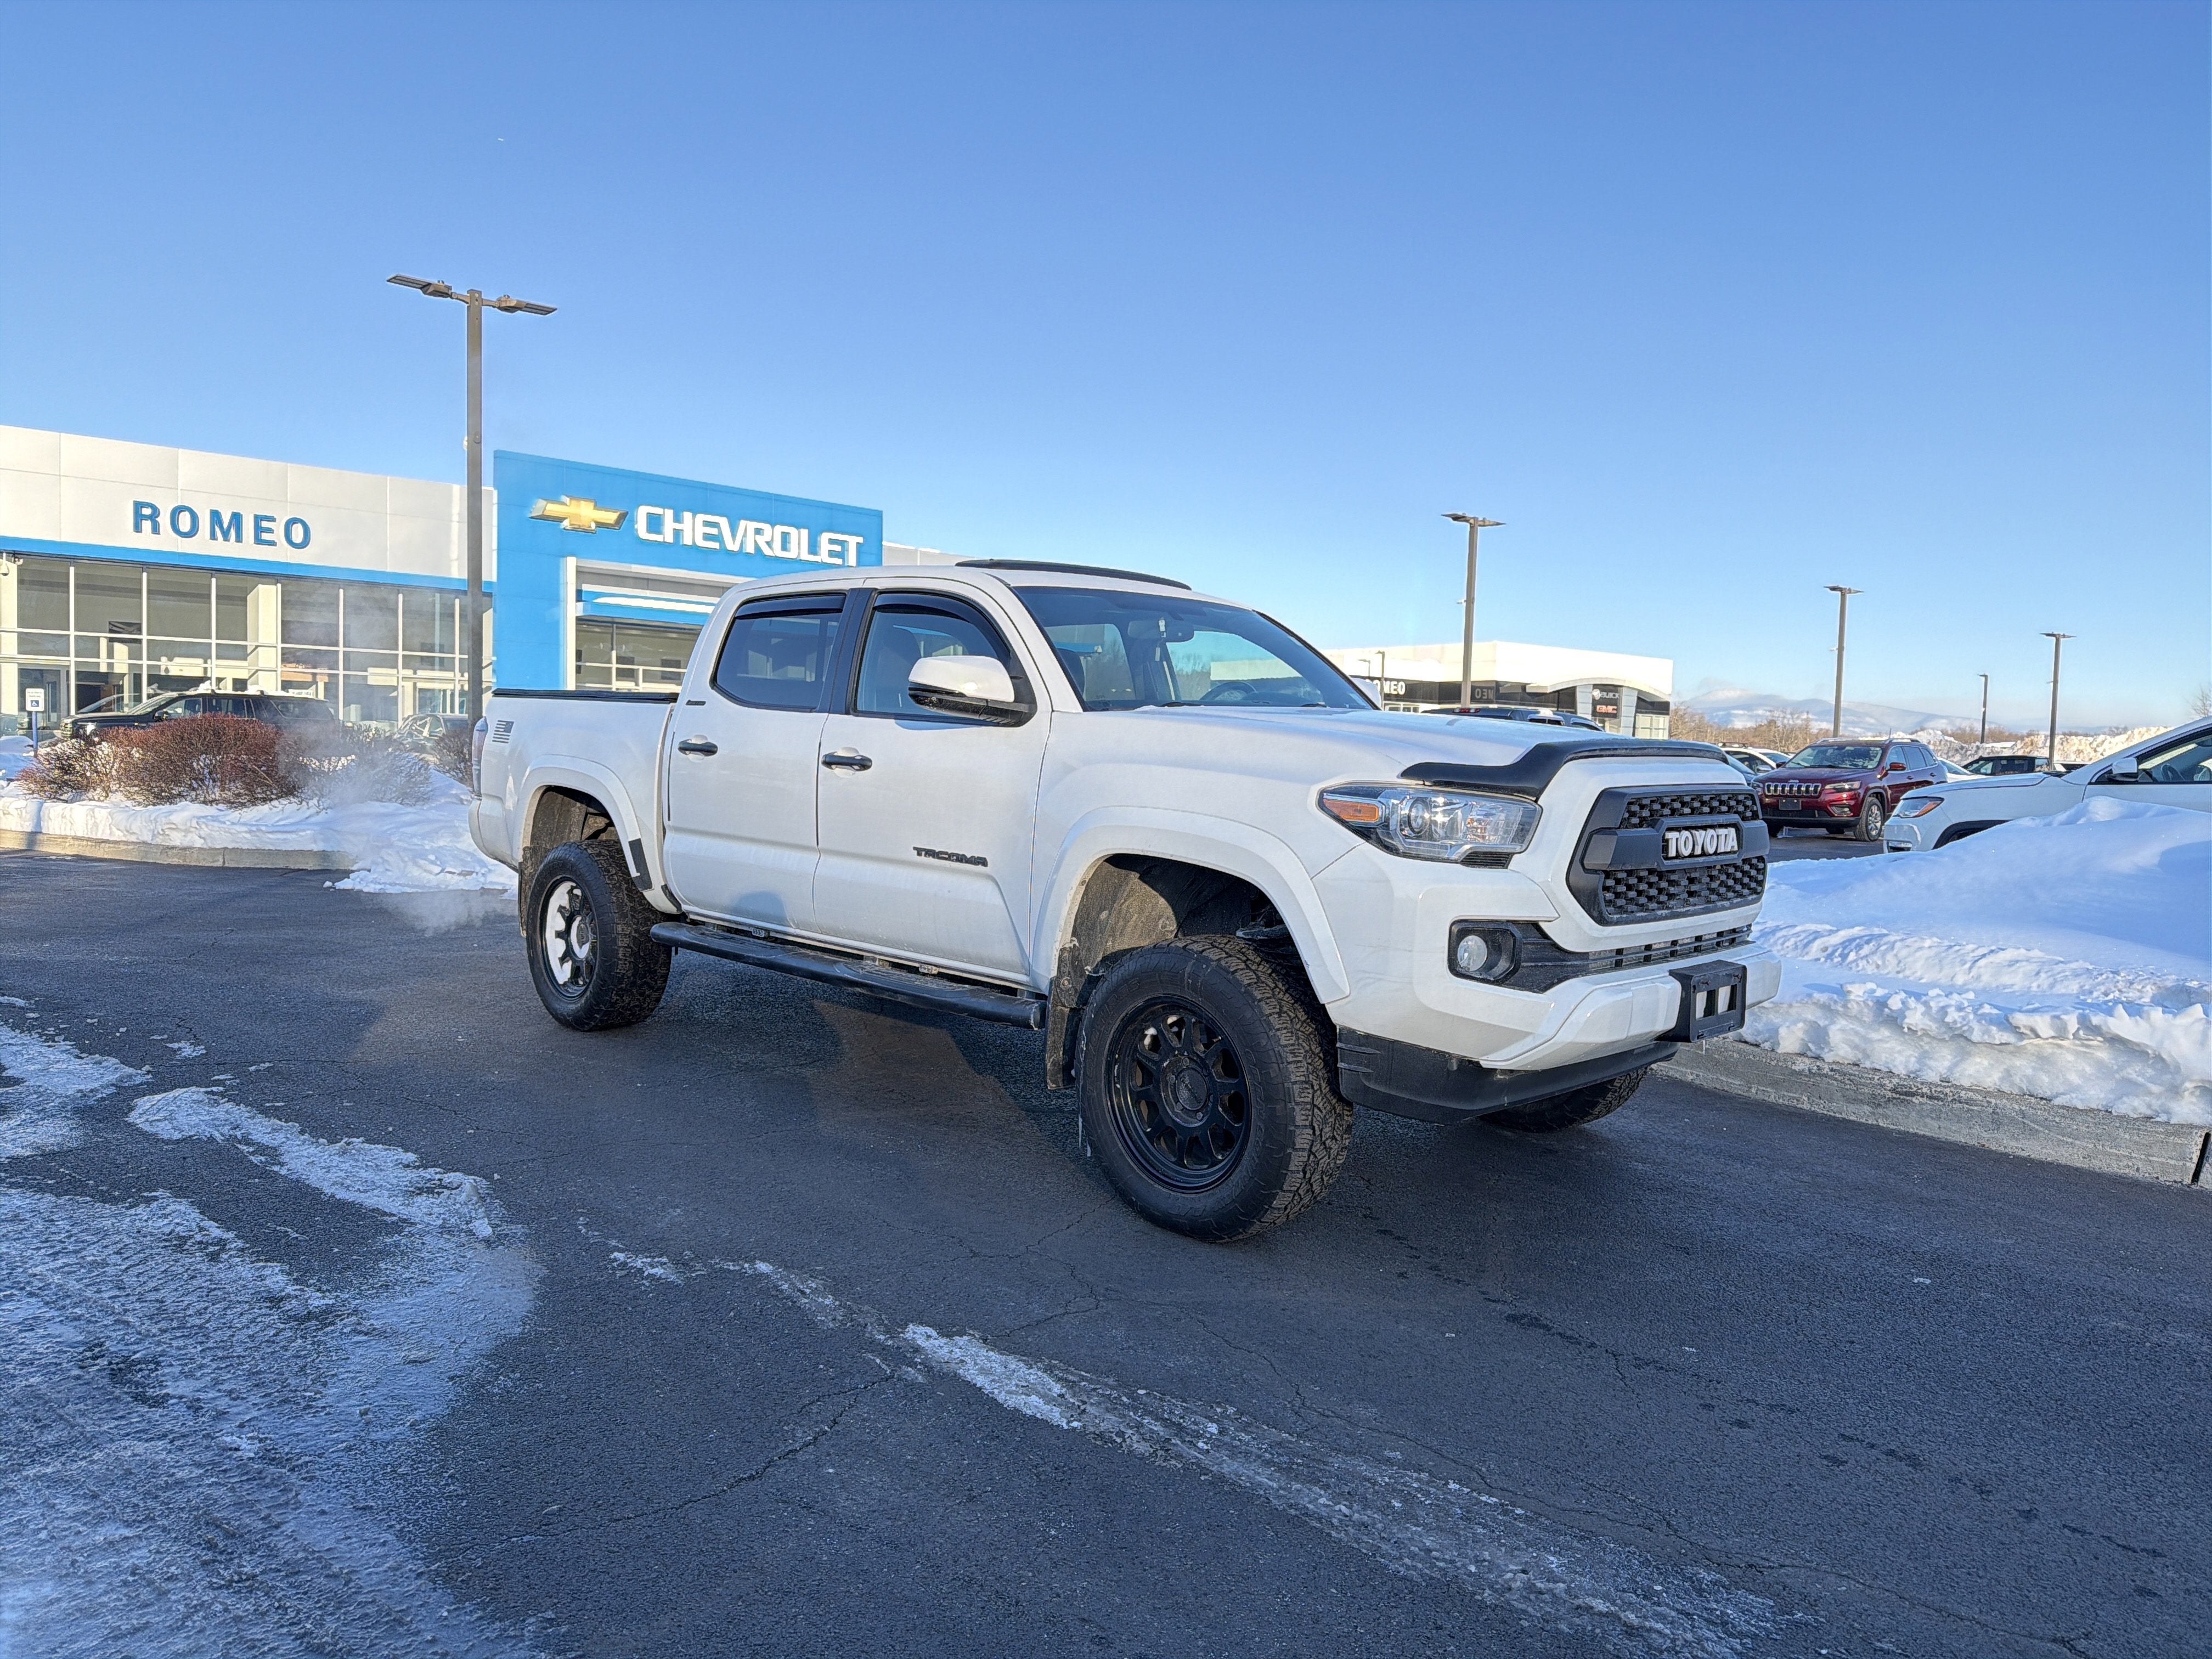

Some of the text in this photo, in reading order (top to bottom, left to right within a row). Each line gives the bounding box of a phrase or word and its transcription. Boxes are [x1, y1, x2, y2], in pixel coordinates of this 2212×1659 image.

[133, 500, 311, 549] ROMEO
[636, 505, 863, 567] CHEVROLET
[1596, 705, 1617, 713] GMC
[913, 847, 988, 867] TACOMA
[1665, 827, 1738, 857] TOYOTA
